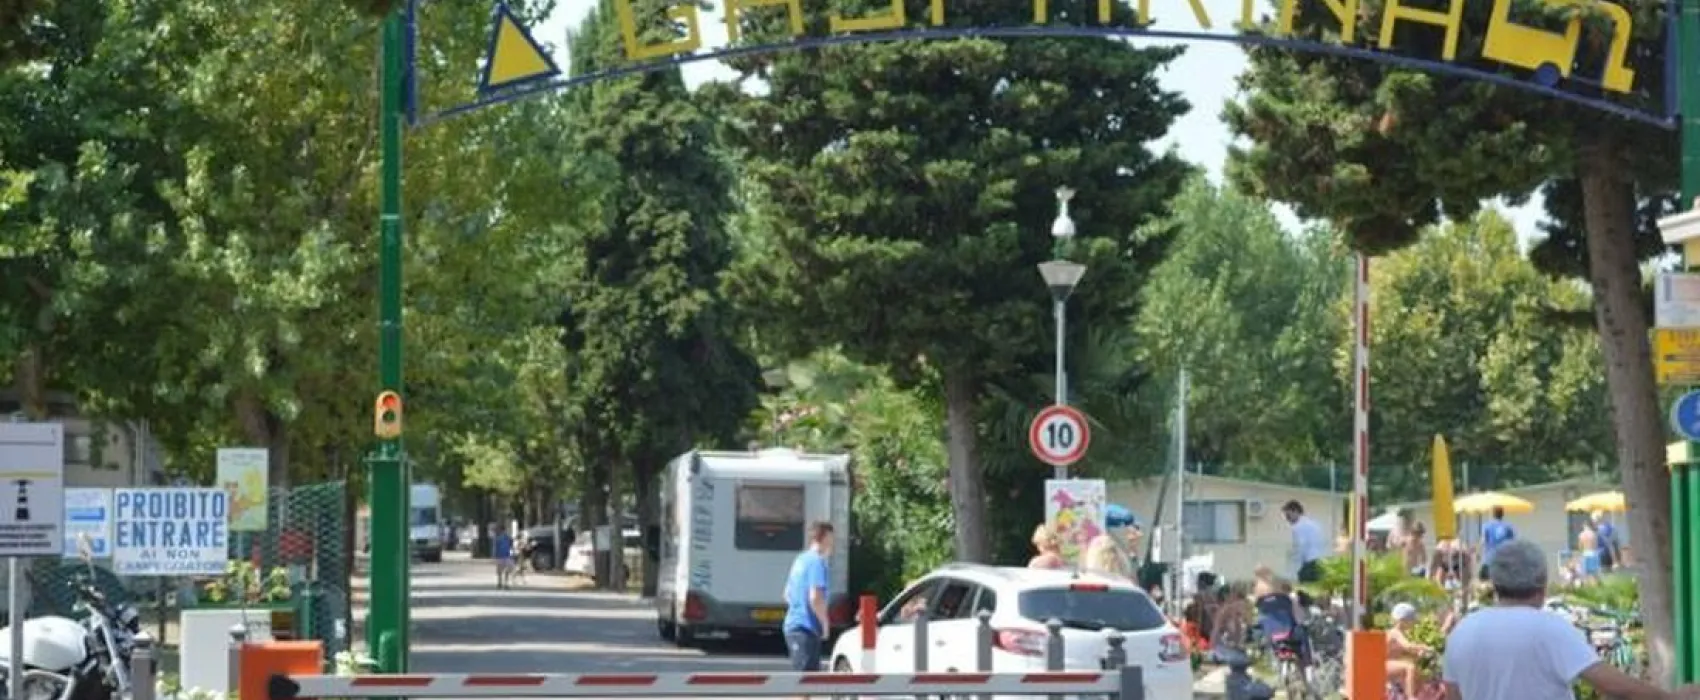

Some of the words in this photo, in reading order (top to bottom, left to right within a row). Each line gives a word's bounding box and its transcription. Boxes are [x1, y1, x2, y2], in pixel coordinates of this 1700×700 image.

[616, 0, 1466, 60] GASNA
[1047, 422, 1073, 449] 10
[117, 491, 225, 519] PROIBITO
[117, 520, 225, 547] ENTRARE
[140, 549, 157, 559] AI
[167, 549, 200, 559] NON
